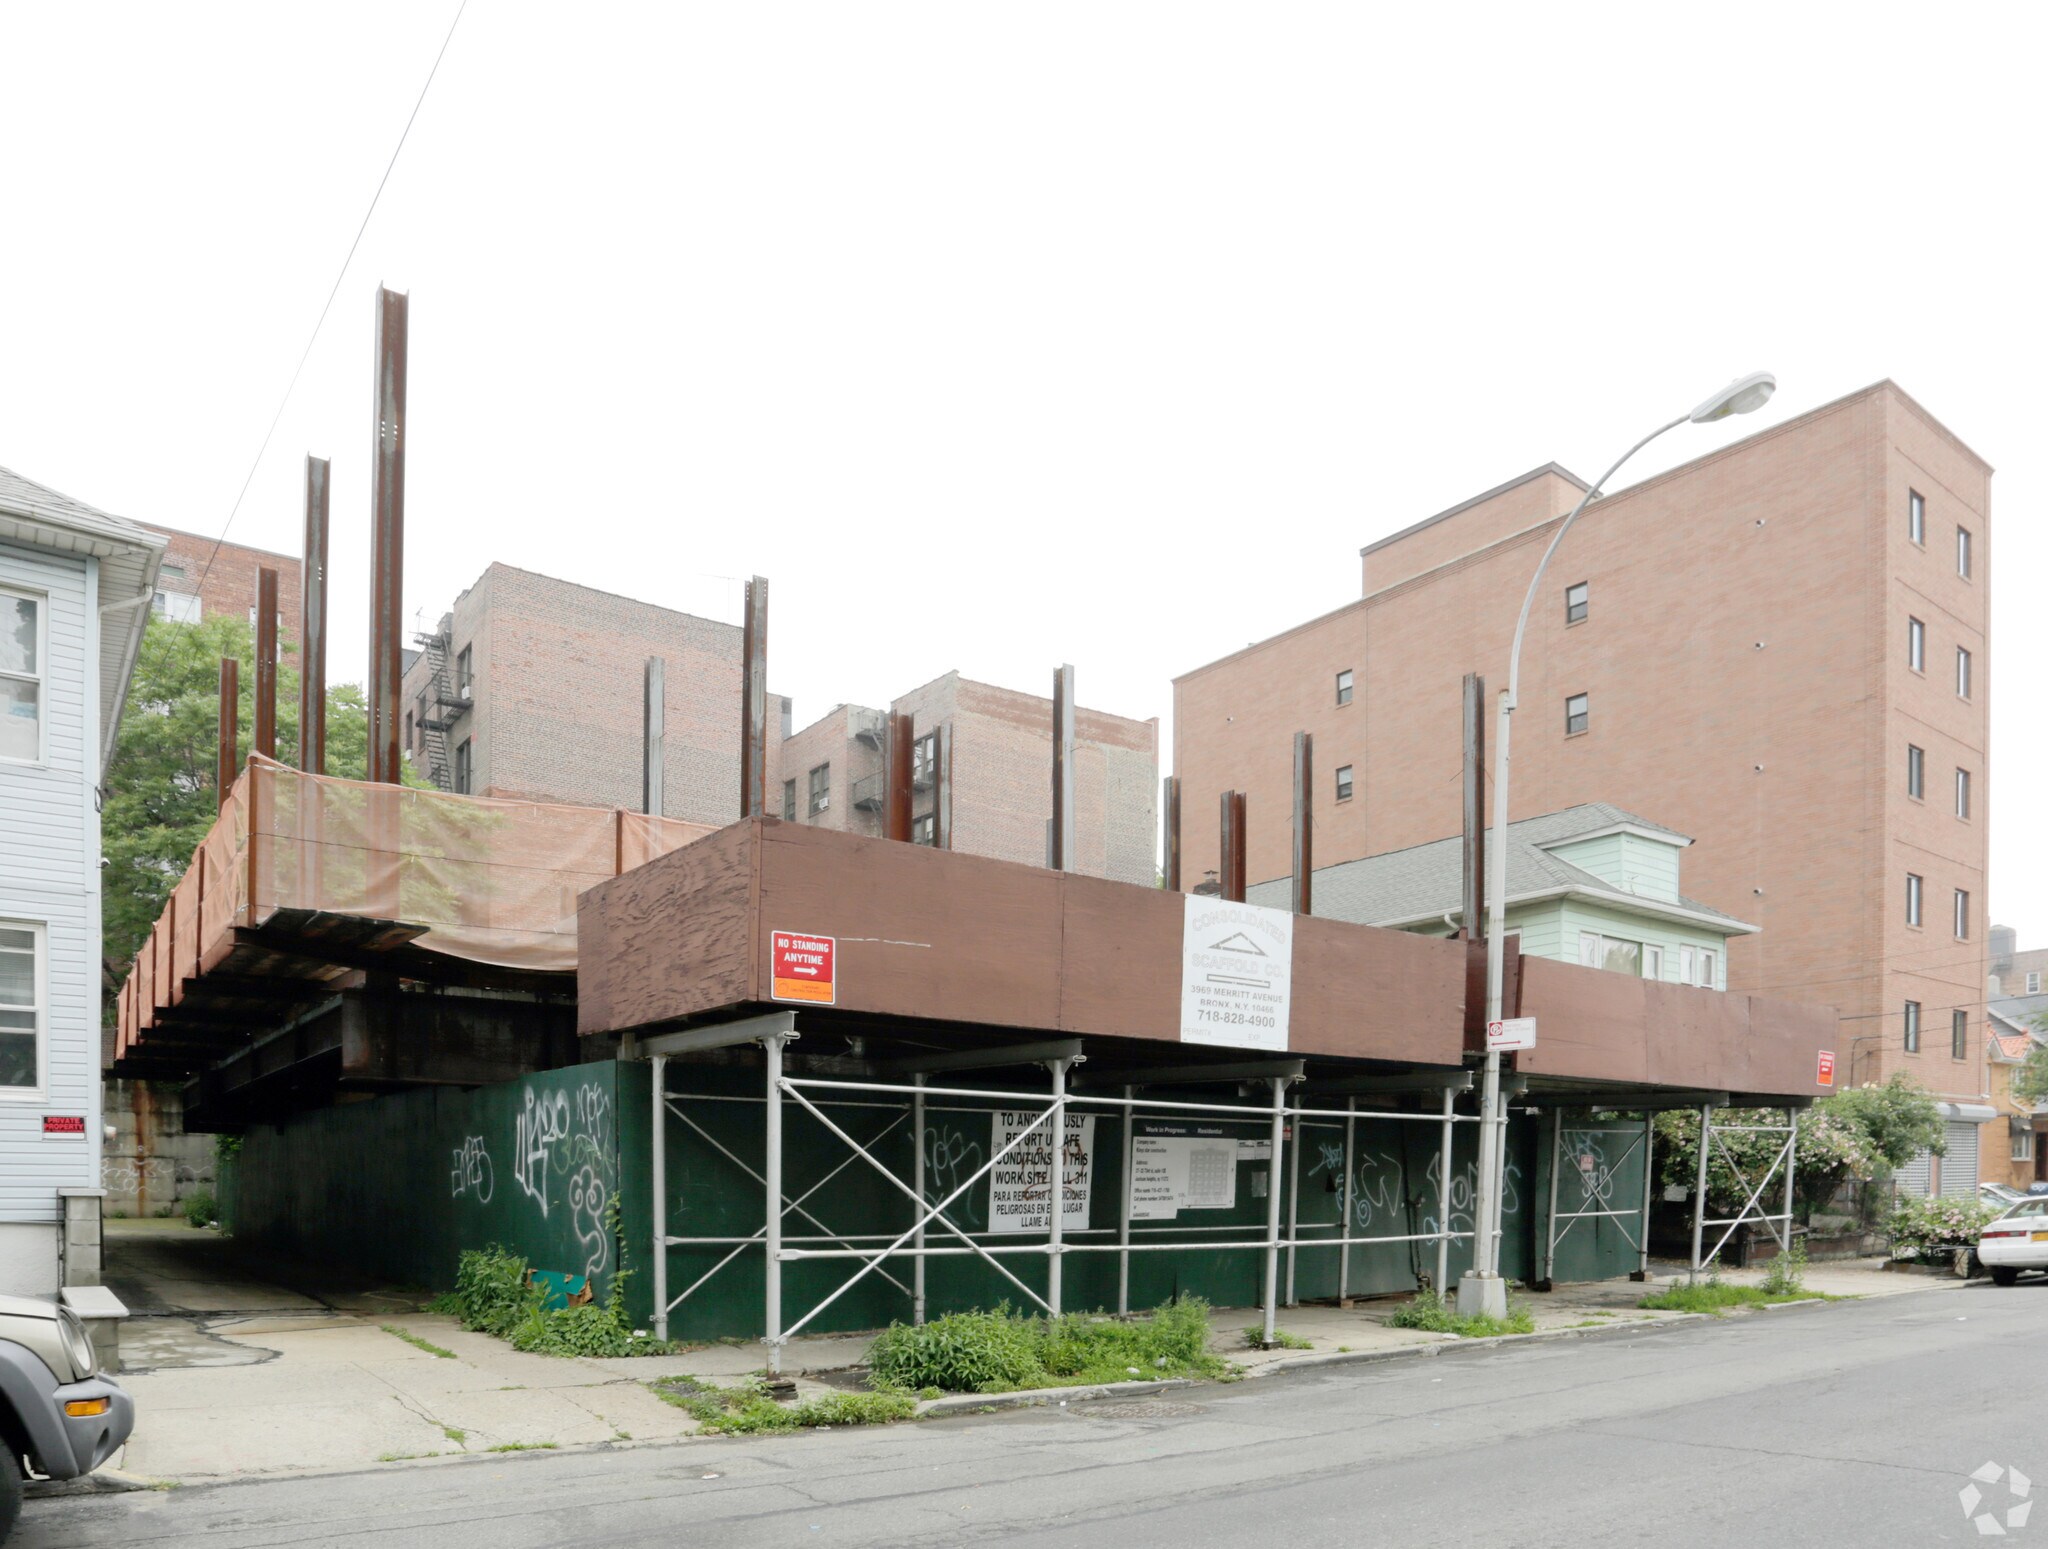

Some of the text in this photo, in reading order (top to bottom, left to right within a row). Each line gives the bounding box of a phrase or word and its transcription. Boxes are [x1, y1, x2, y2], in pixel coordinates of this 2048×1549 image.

[1191, 909, 1287, 945] CONSOLIDATED
[777, 938, 829, 952] NO STANDING
[783, 952, 823, 965] ANYTIME
[1191, 953, 1259, 975] SCAFFOLD
[1213, 988, 1250, 999] MERRITT
[1252, 992, 1284, 1003] AVENUE
[1197, 1009, 1276, 1028] 718-828-4900
[1001, 1112, 1014, 1127] TO
[44, 1123, 84, 1131] PROPERTY
[1069, 1152, 1089, 1166] THIS
[995, 1171, 1024, 1185] WORK
[1027, 1171, 1048, 1185] SITE
[1075, 1171, 1088, 1185] 311
[993, 1191, 1011, 1202] PARA
[1013, 1190, 1046, 1202] REPORTAR
[996, 1203, 1036, 1215] PELIGROSAS
[1037, 1203, 1046, 1214] EN
[1063, 1202, 1083, 1213] LUGAR
[1021, 1216, 1042, 1228] LLAME
